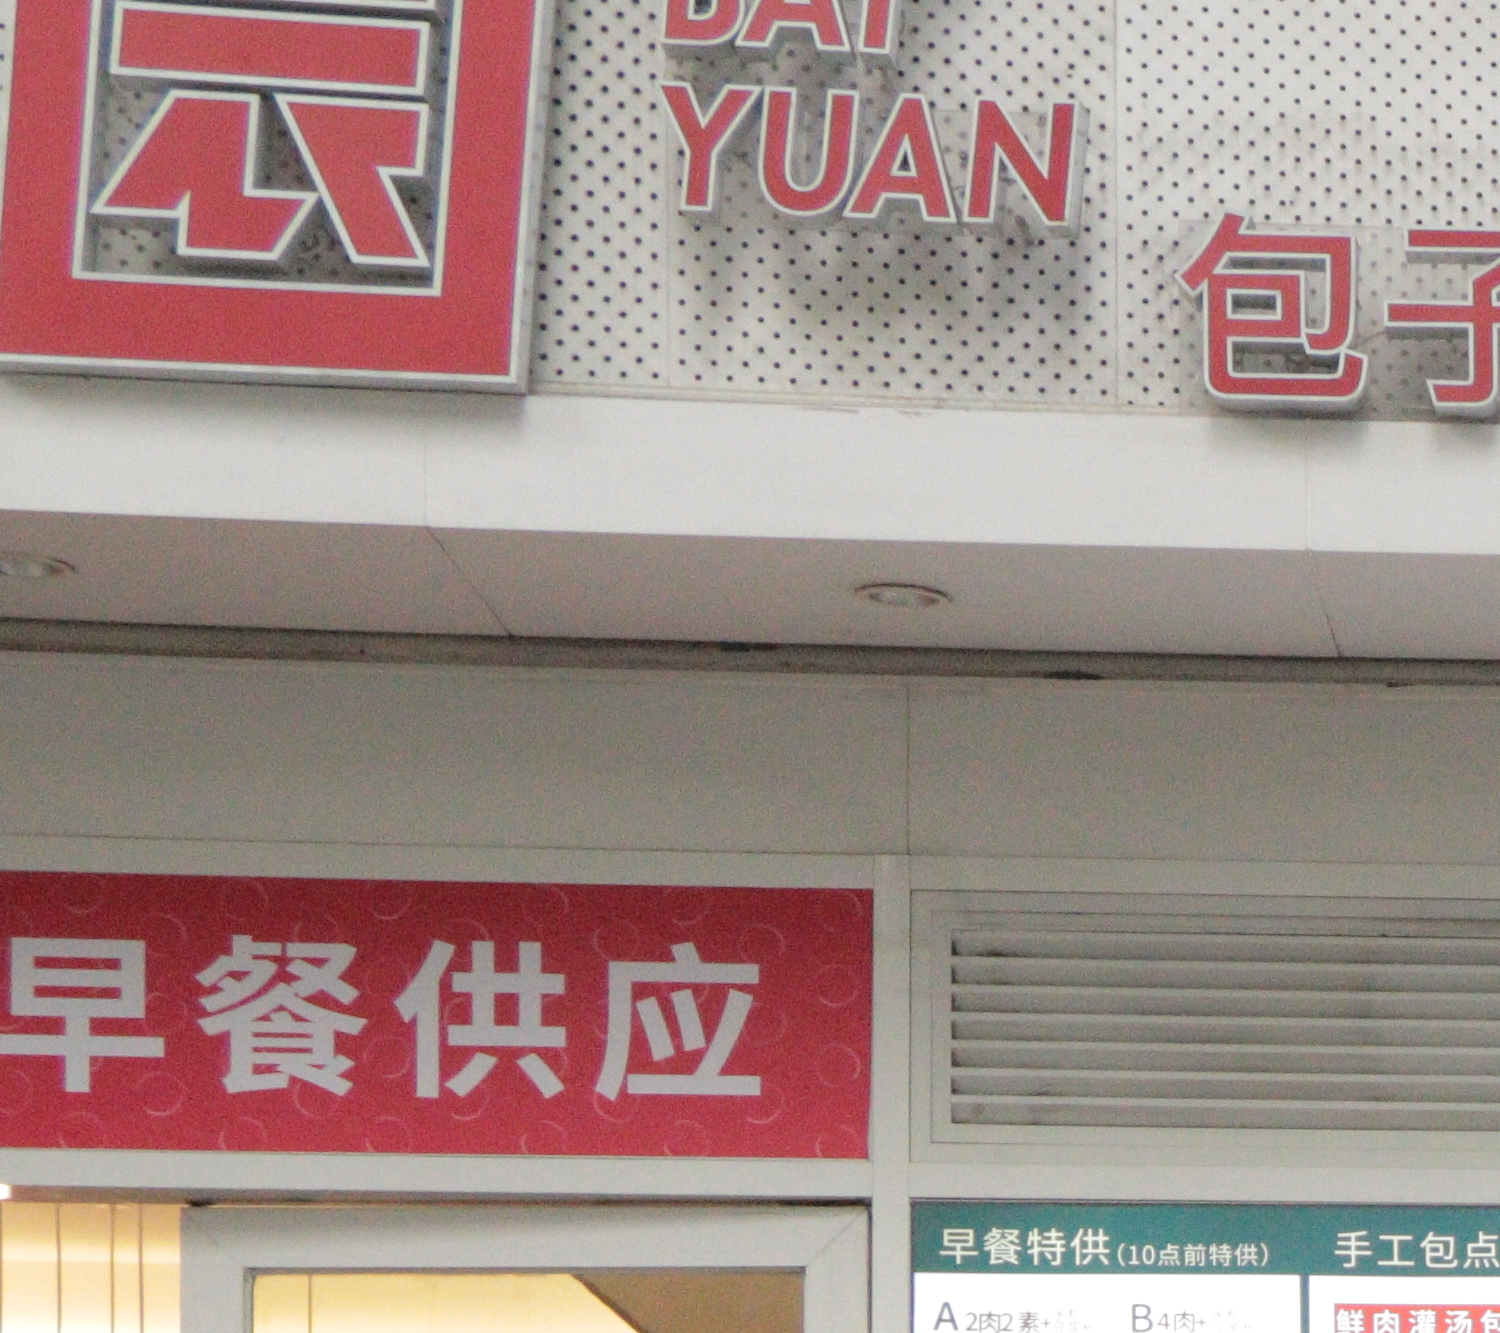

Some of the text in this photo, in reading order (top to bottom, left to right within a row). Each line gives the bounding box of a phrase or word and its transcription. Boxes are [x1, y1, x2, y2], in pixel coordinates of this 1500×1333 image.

[660, 82, 1078, 225] YUAN
[0, 935, 762, 1102] 早餐供应
[938, 1228, 1271, 1268] 早餐特供 (10点前特供)
[934, 1301, 958, 1332] A
[1131, 1303, 1153, 1333] B
